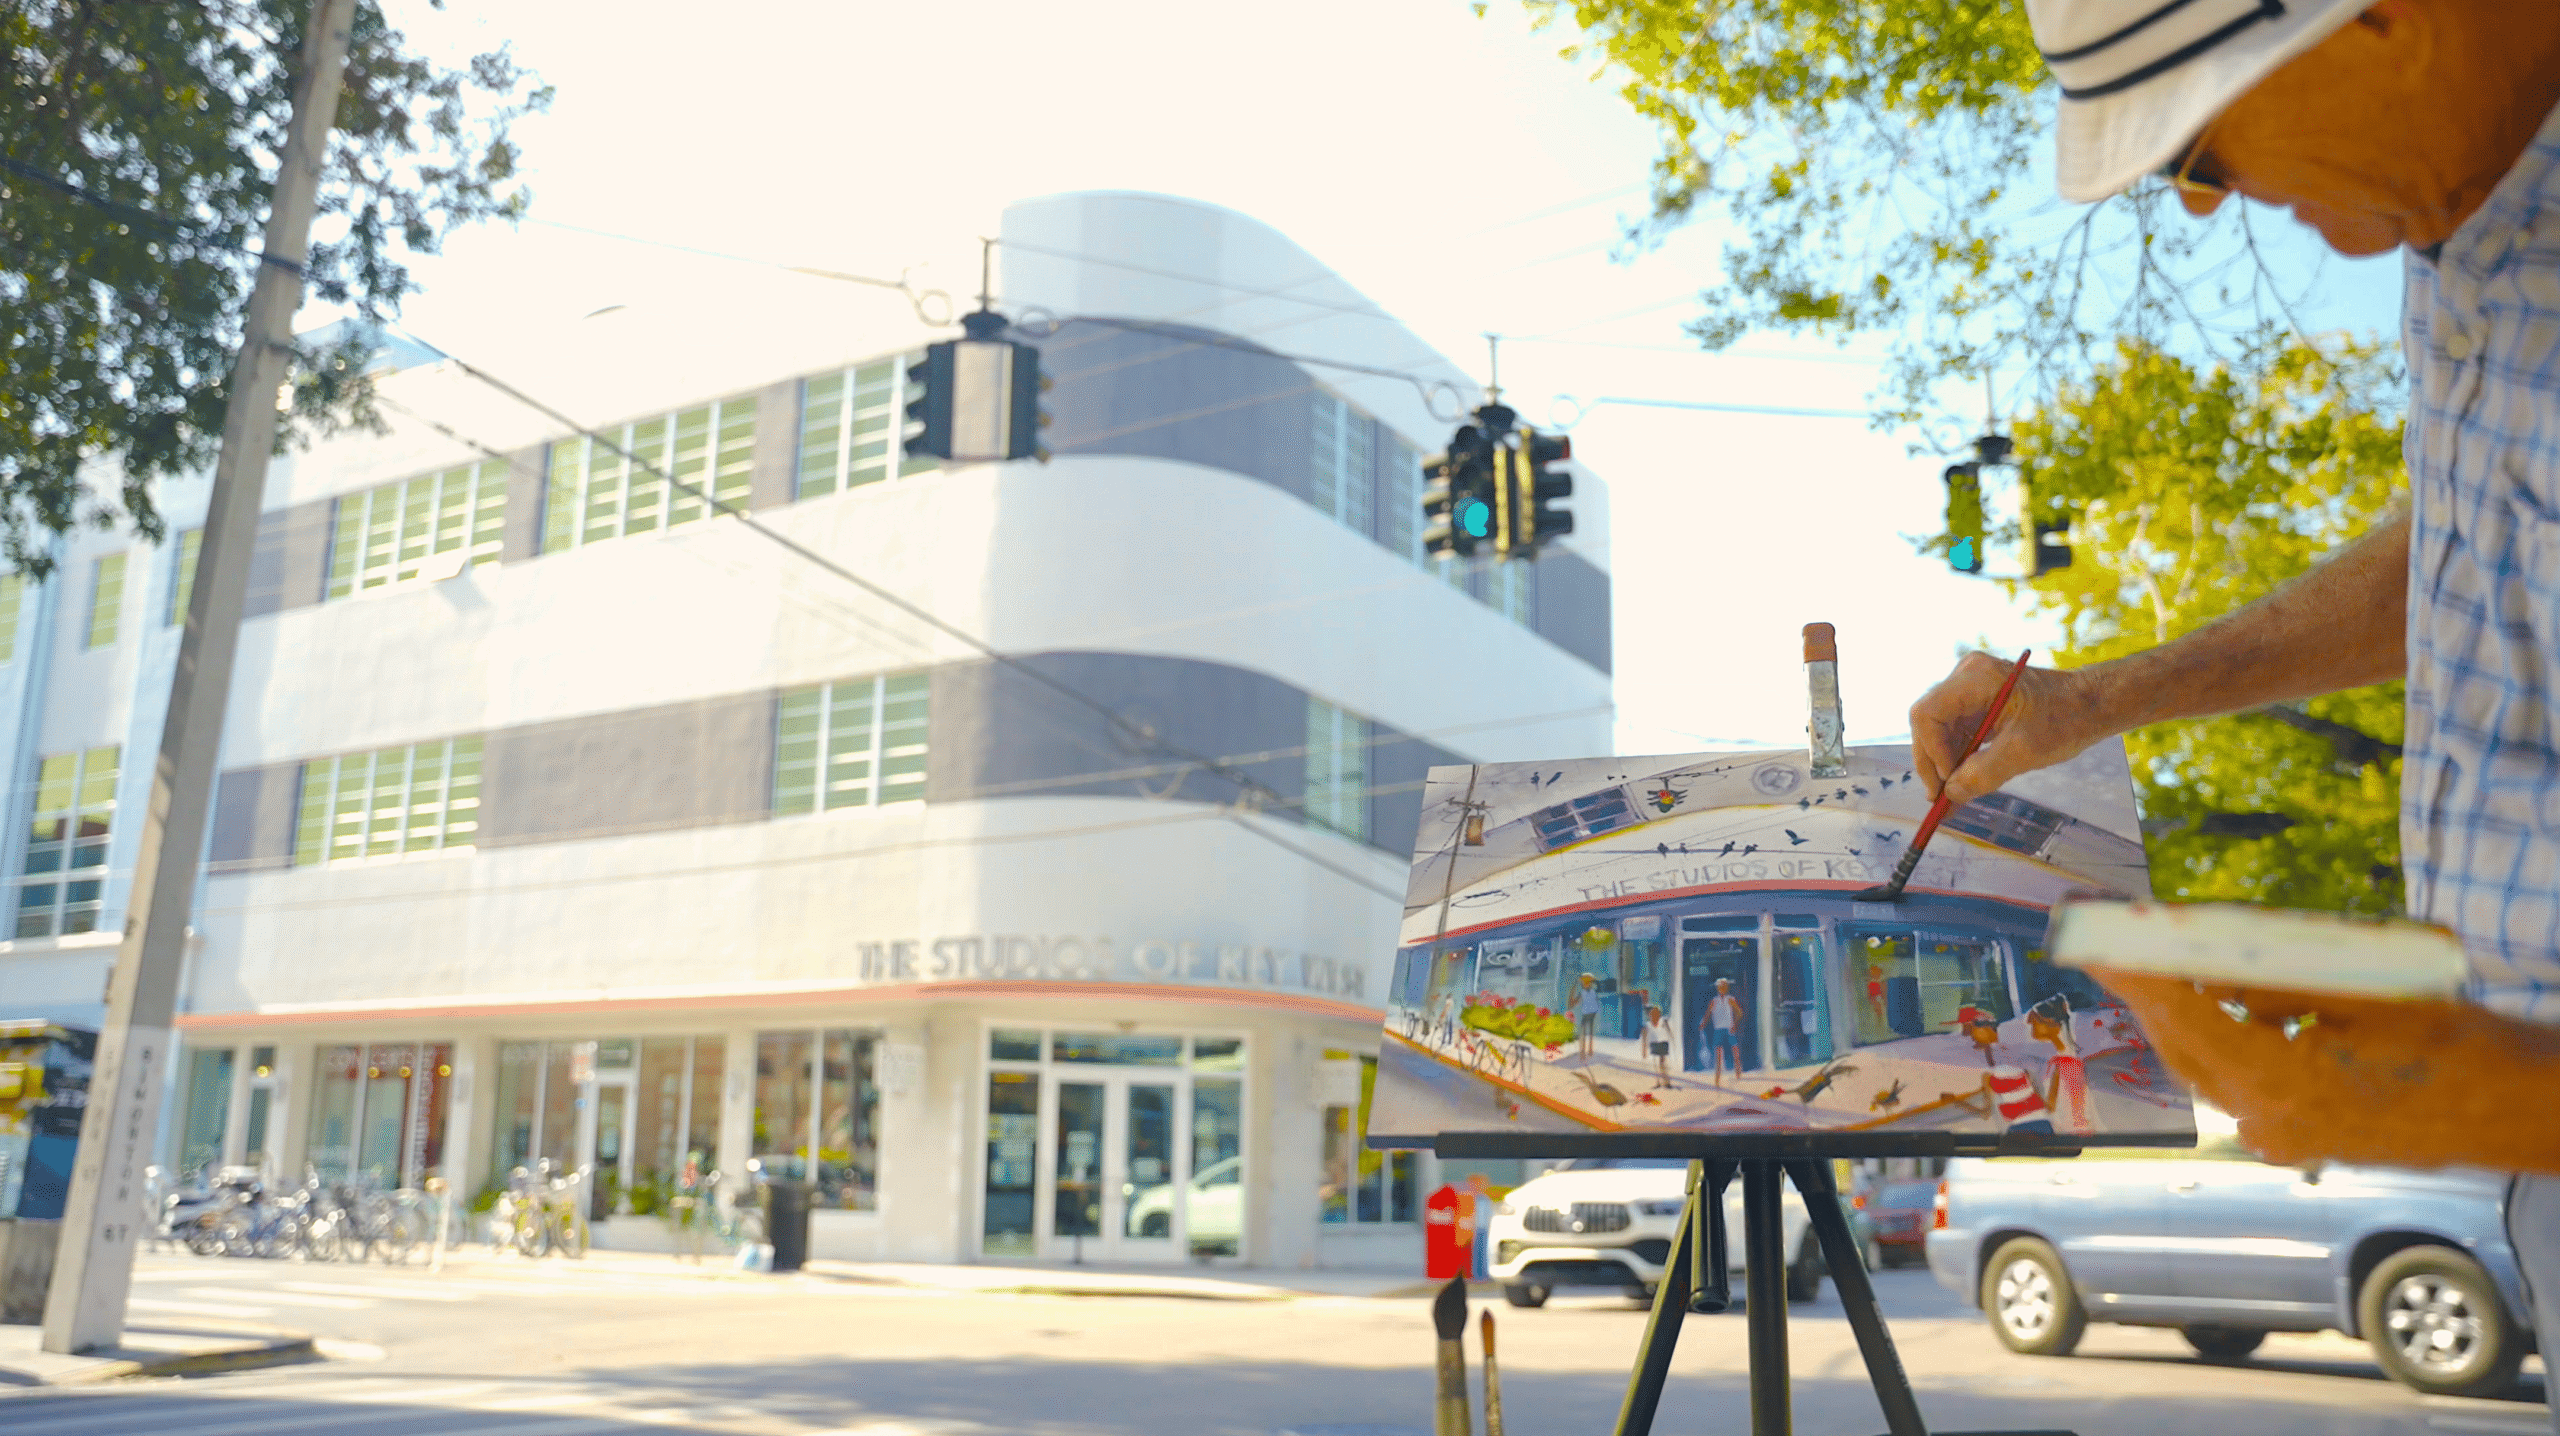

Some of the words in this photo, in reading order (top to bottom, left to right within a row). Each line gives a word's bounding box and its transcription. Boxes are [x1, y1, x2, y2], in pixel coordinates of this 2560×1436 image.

[1577, 876, 1639, 902] THE
[1646, 859, 1769, 888] STUDIOS
[1778, 860, 1817, 878] OF
[1823, 858, 1876, 880] KEY
[857, 938, 920, 982] THE
[930, 935, 1113, 981] STUDIOS
[1132, 939, 1201, 978] OF
